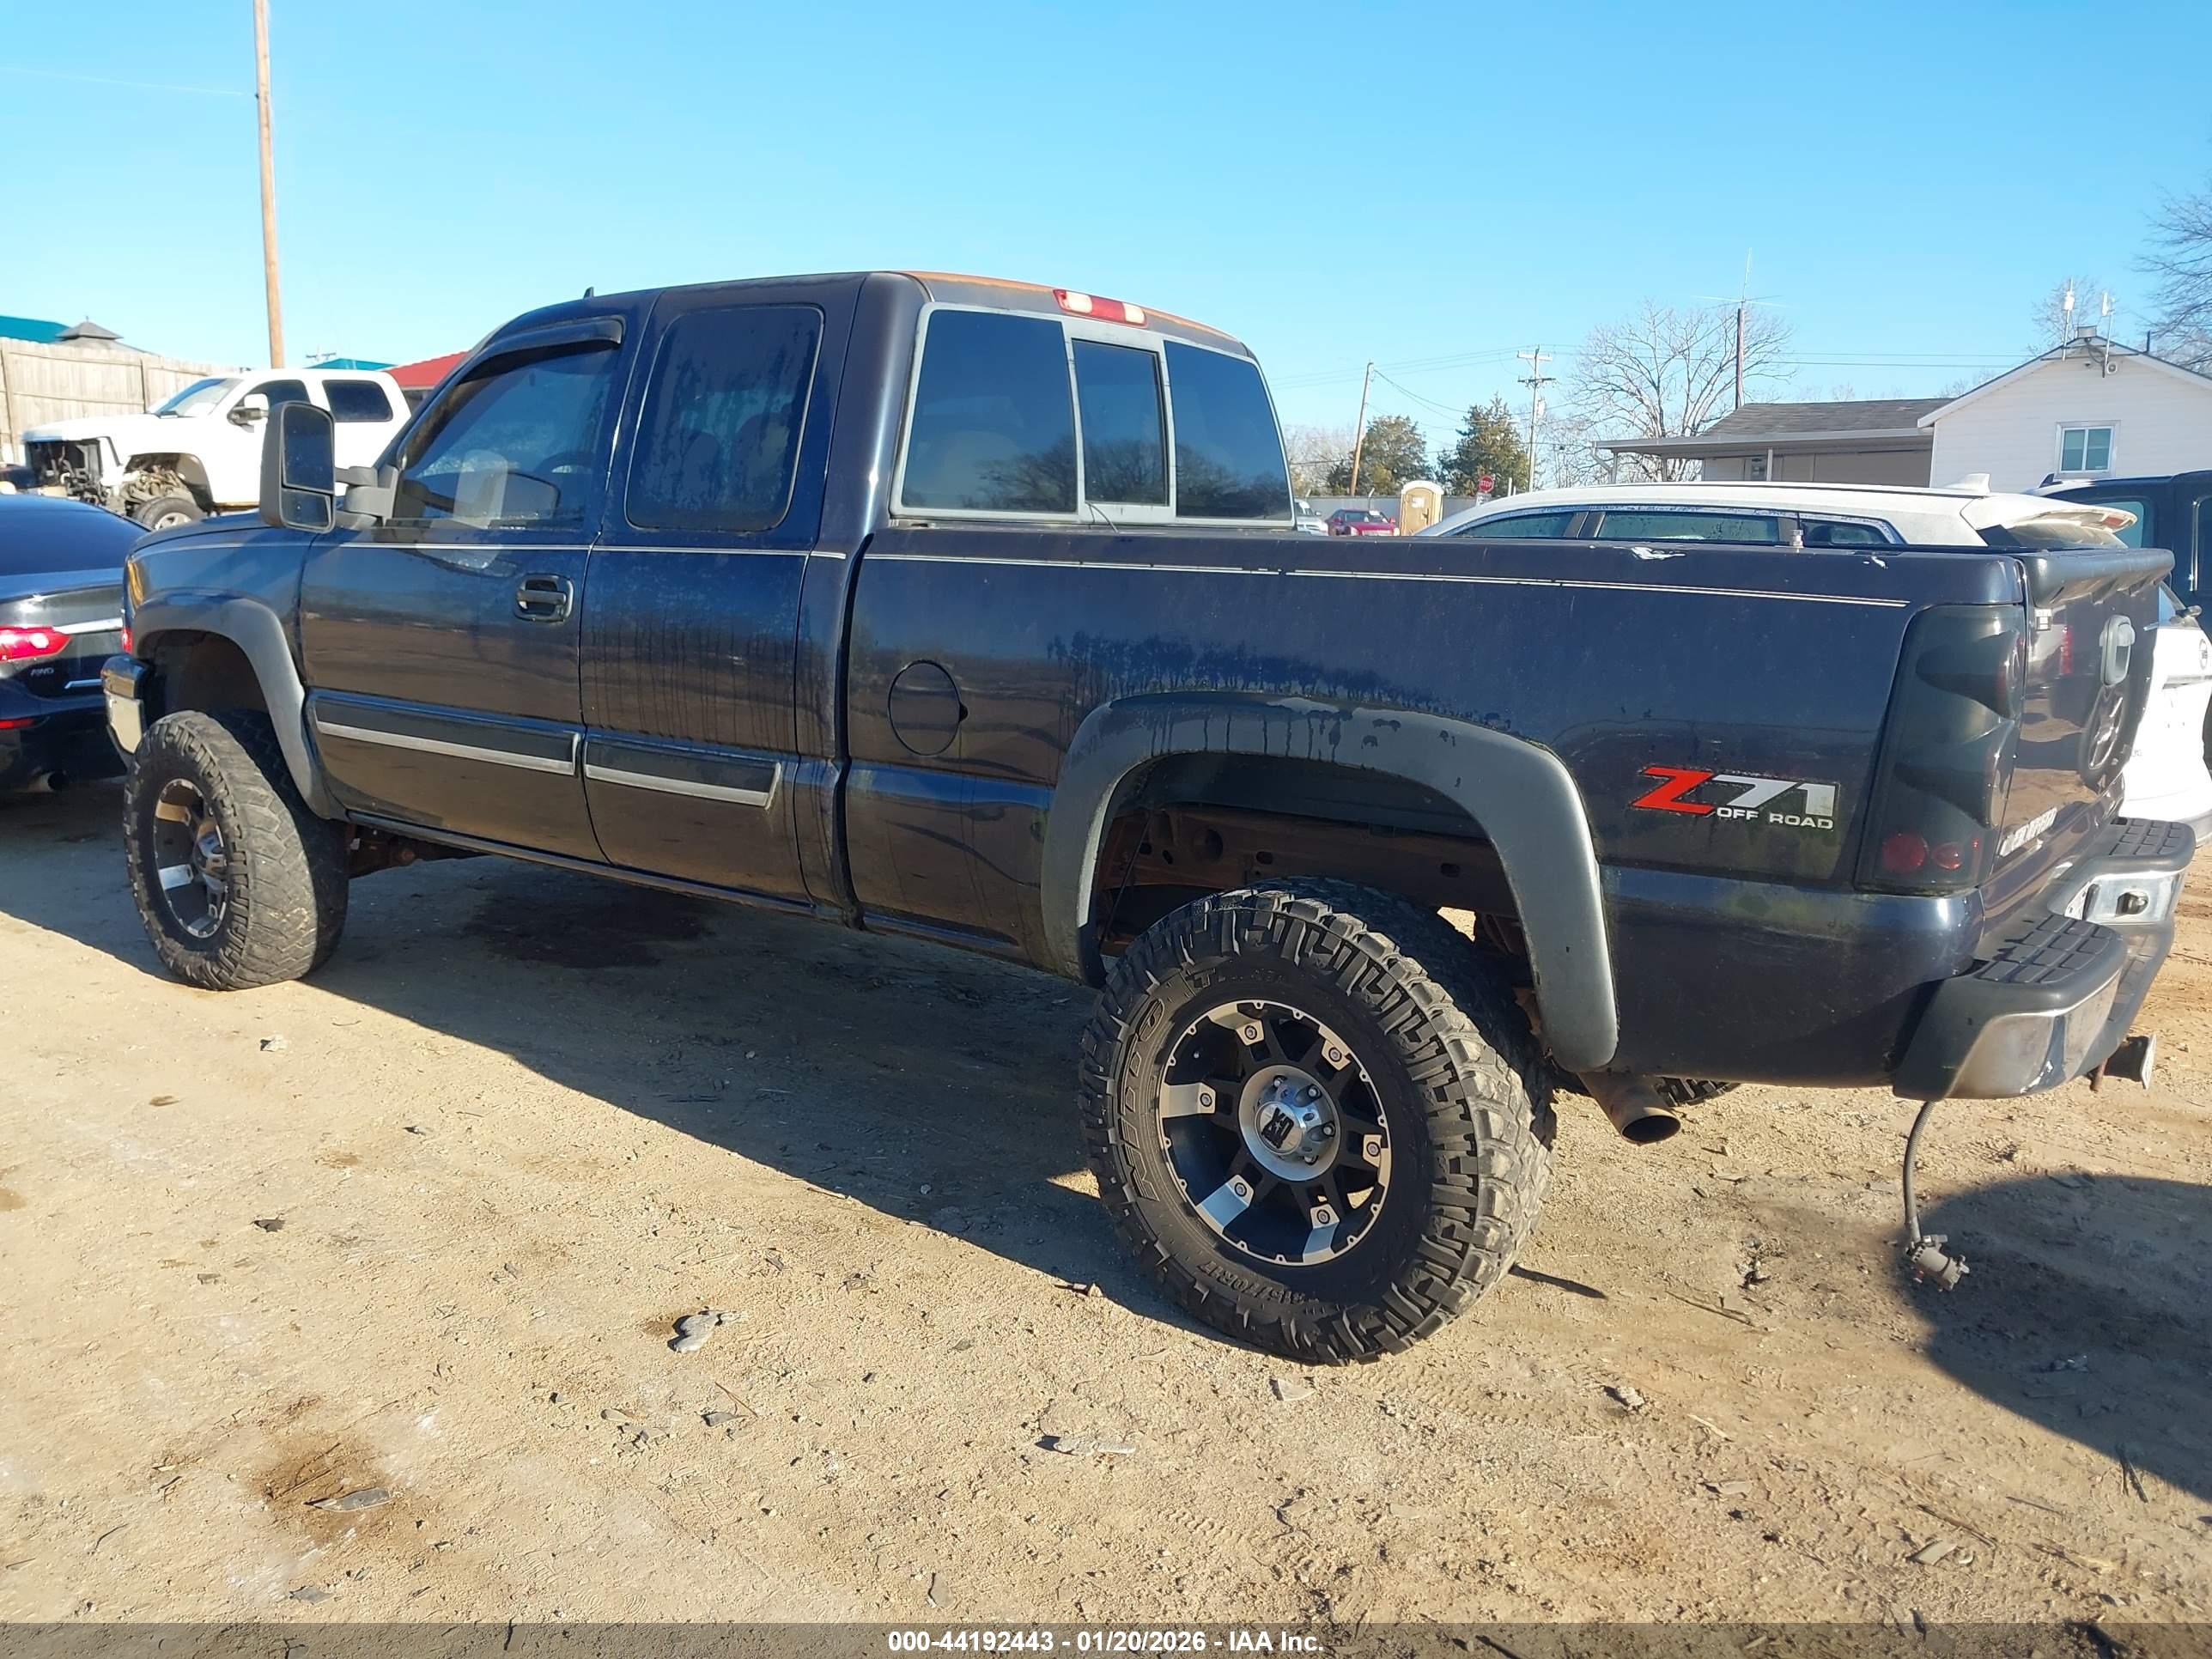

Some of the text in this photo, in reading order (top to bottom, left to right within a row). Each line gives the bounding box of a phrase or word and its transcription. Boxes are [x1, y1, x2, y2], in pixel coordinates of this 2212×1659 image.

[1633, 766, 1836, 817] Z71
[1716, 807, 1834, 830] OFF ROAD
